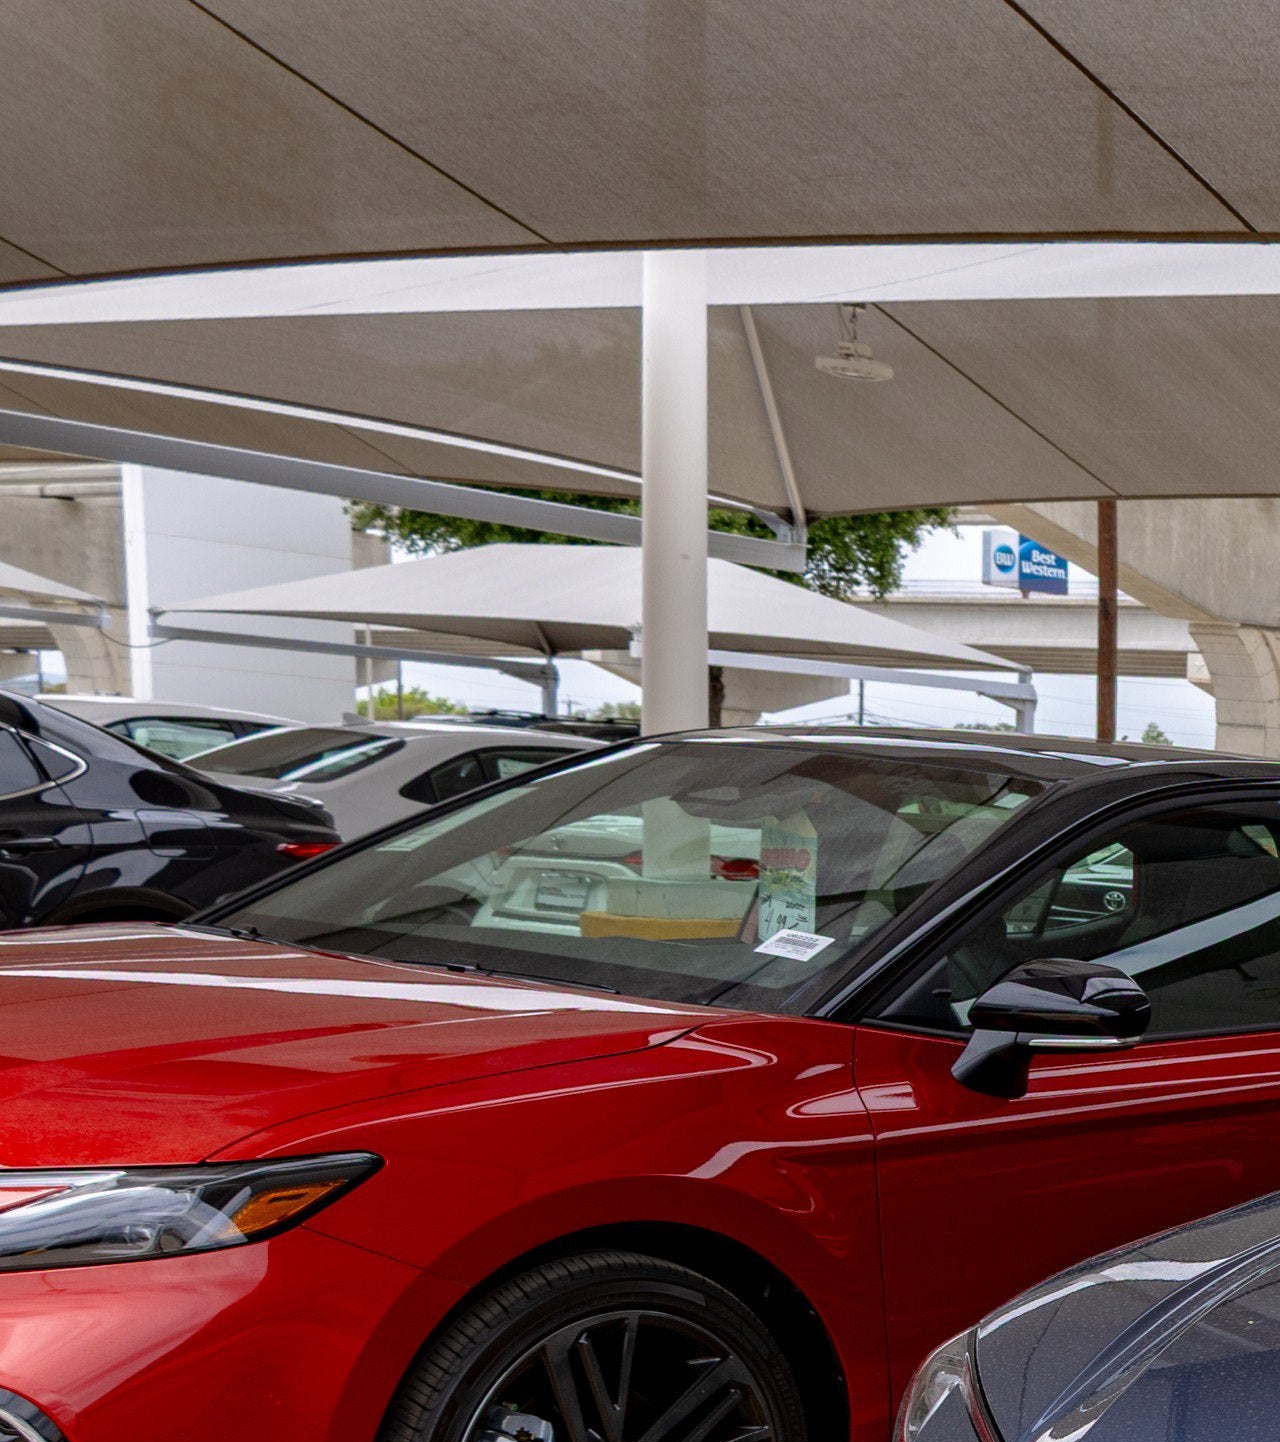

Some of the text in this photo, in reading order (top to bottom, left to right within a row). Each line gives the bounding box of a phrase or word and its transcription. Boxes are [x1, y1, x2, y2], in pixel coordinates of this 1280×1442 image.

[995, 552, 1014, 567] BW
[1031, 549, 1056, 565] Best
[1021, 560, 1065, 579] Western
